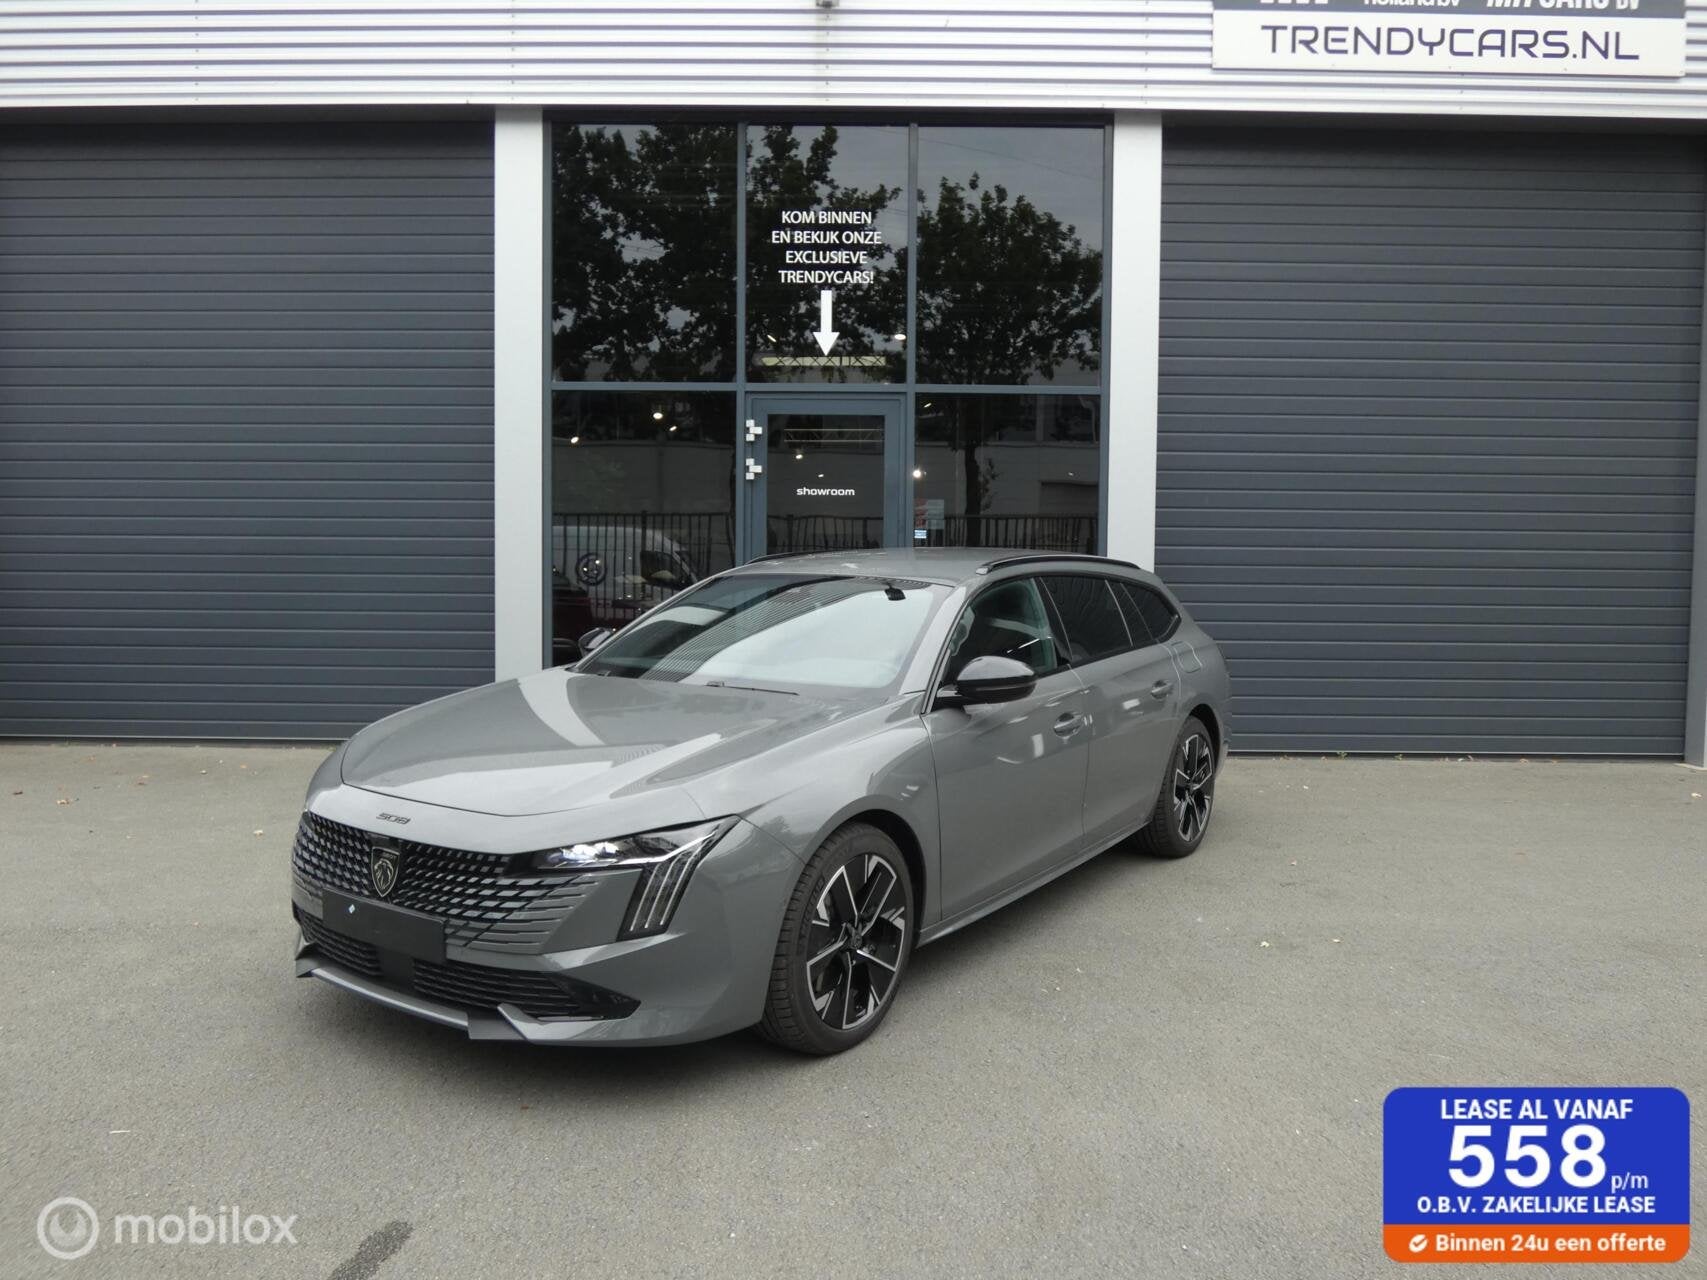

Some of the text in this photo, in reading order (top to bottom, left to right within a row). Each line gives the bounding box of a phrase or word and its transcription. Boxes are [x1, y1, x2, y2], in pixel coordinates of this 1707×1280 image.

[1261, 25, 1640, 60] TRENDYCARS.NL
[781, 211, 872, 224] KOM BINNEN
[771, 230, 883, 245] EN BEKIJK ONZE
[785, 250, 868, 264] EXCLUSIEVE
[778, 270, 874, 284] TRENDYCARS!
[796, 487, 856, 496] showroom
[376, 812, 412, 825] 508
